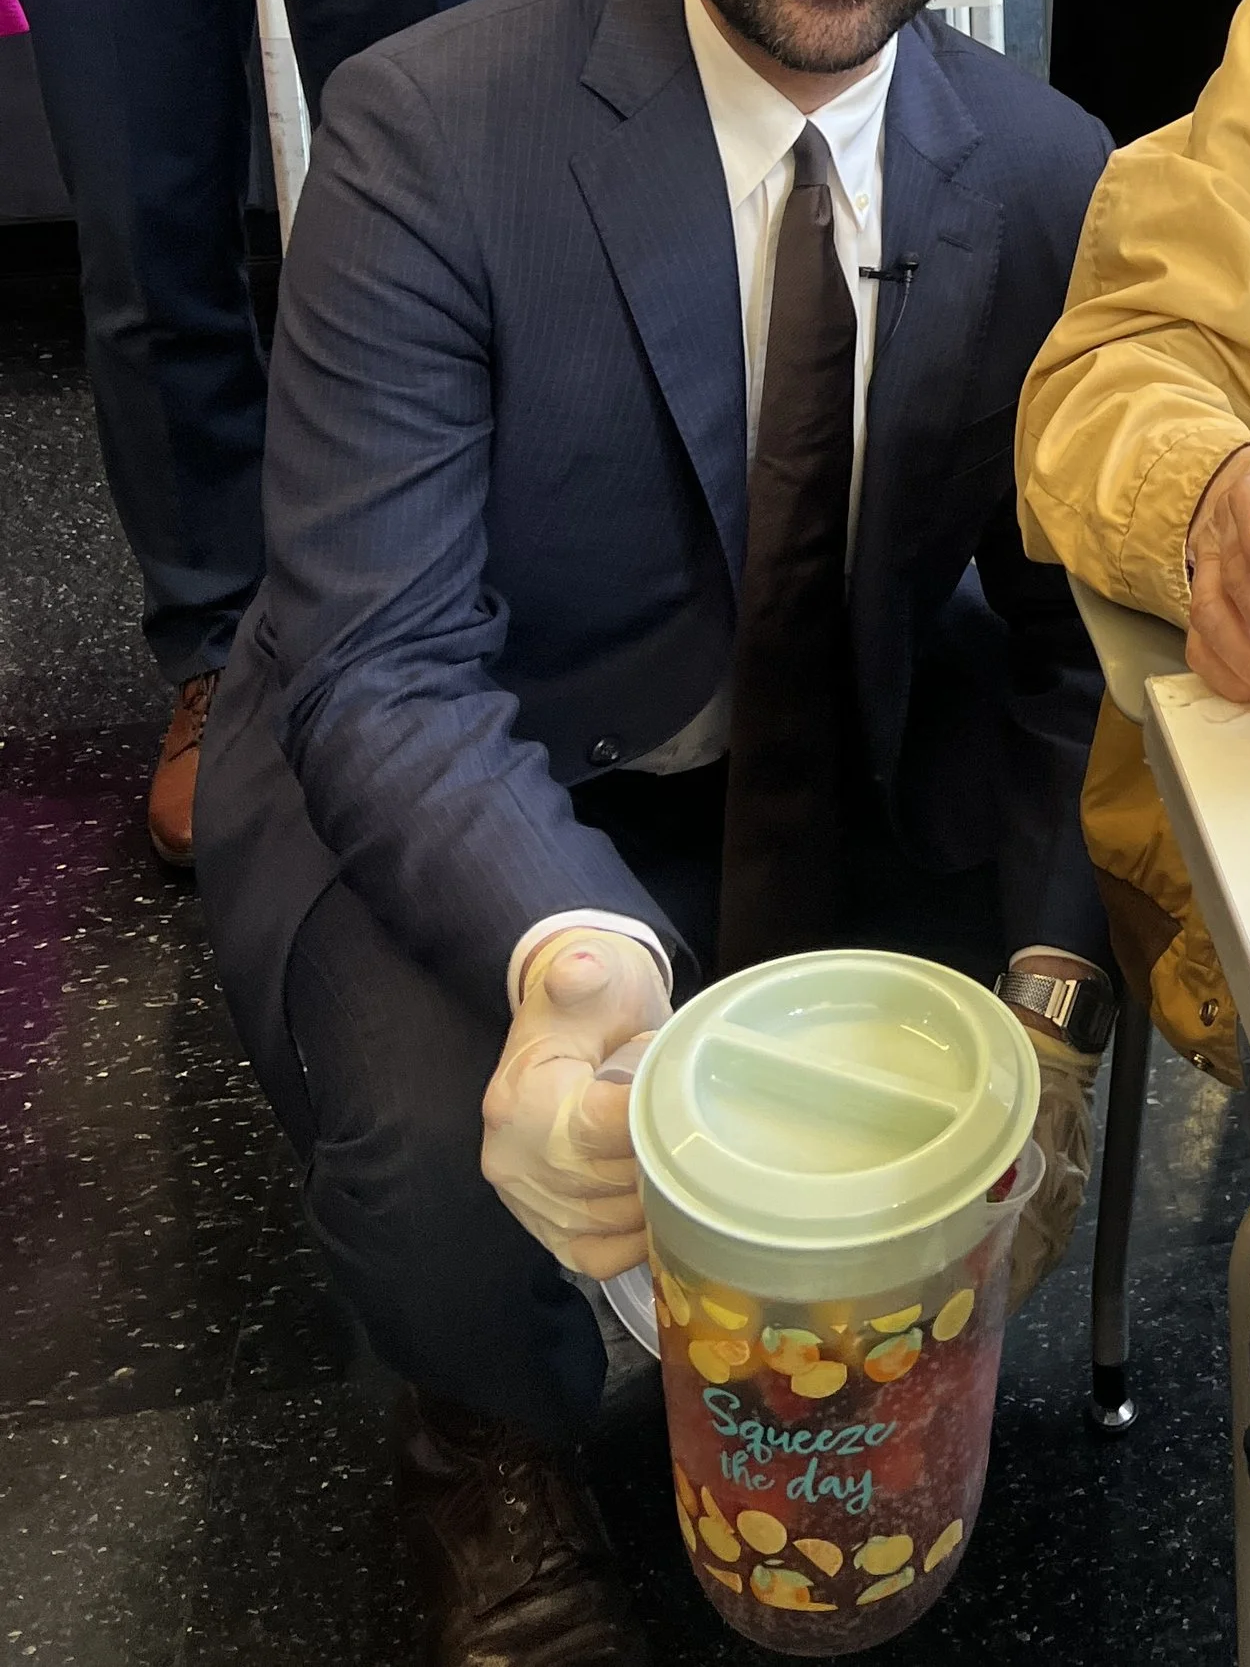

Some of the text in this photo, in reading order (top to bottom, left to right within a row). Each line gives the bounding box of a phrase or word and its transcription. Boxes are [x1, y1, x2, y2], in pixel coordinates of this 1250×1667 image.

[702, 1387, 897, 1464] Squeeze
[720, 1449, 873, 1515] the day
